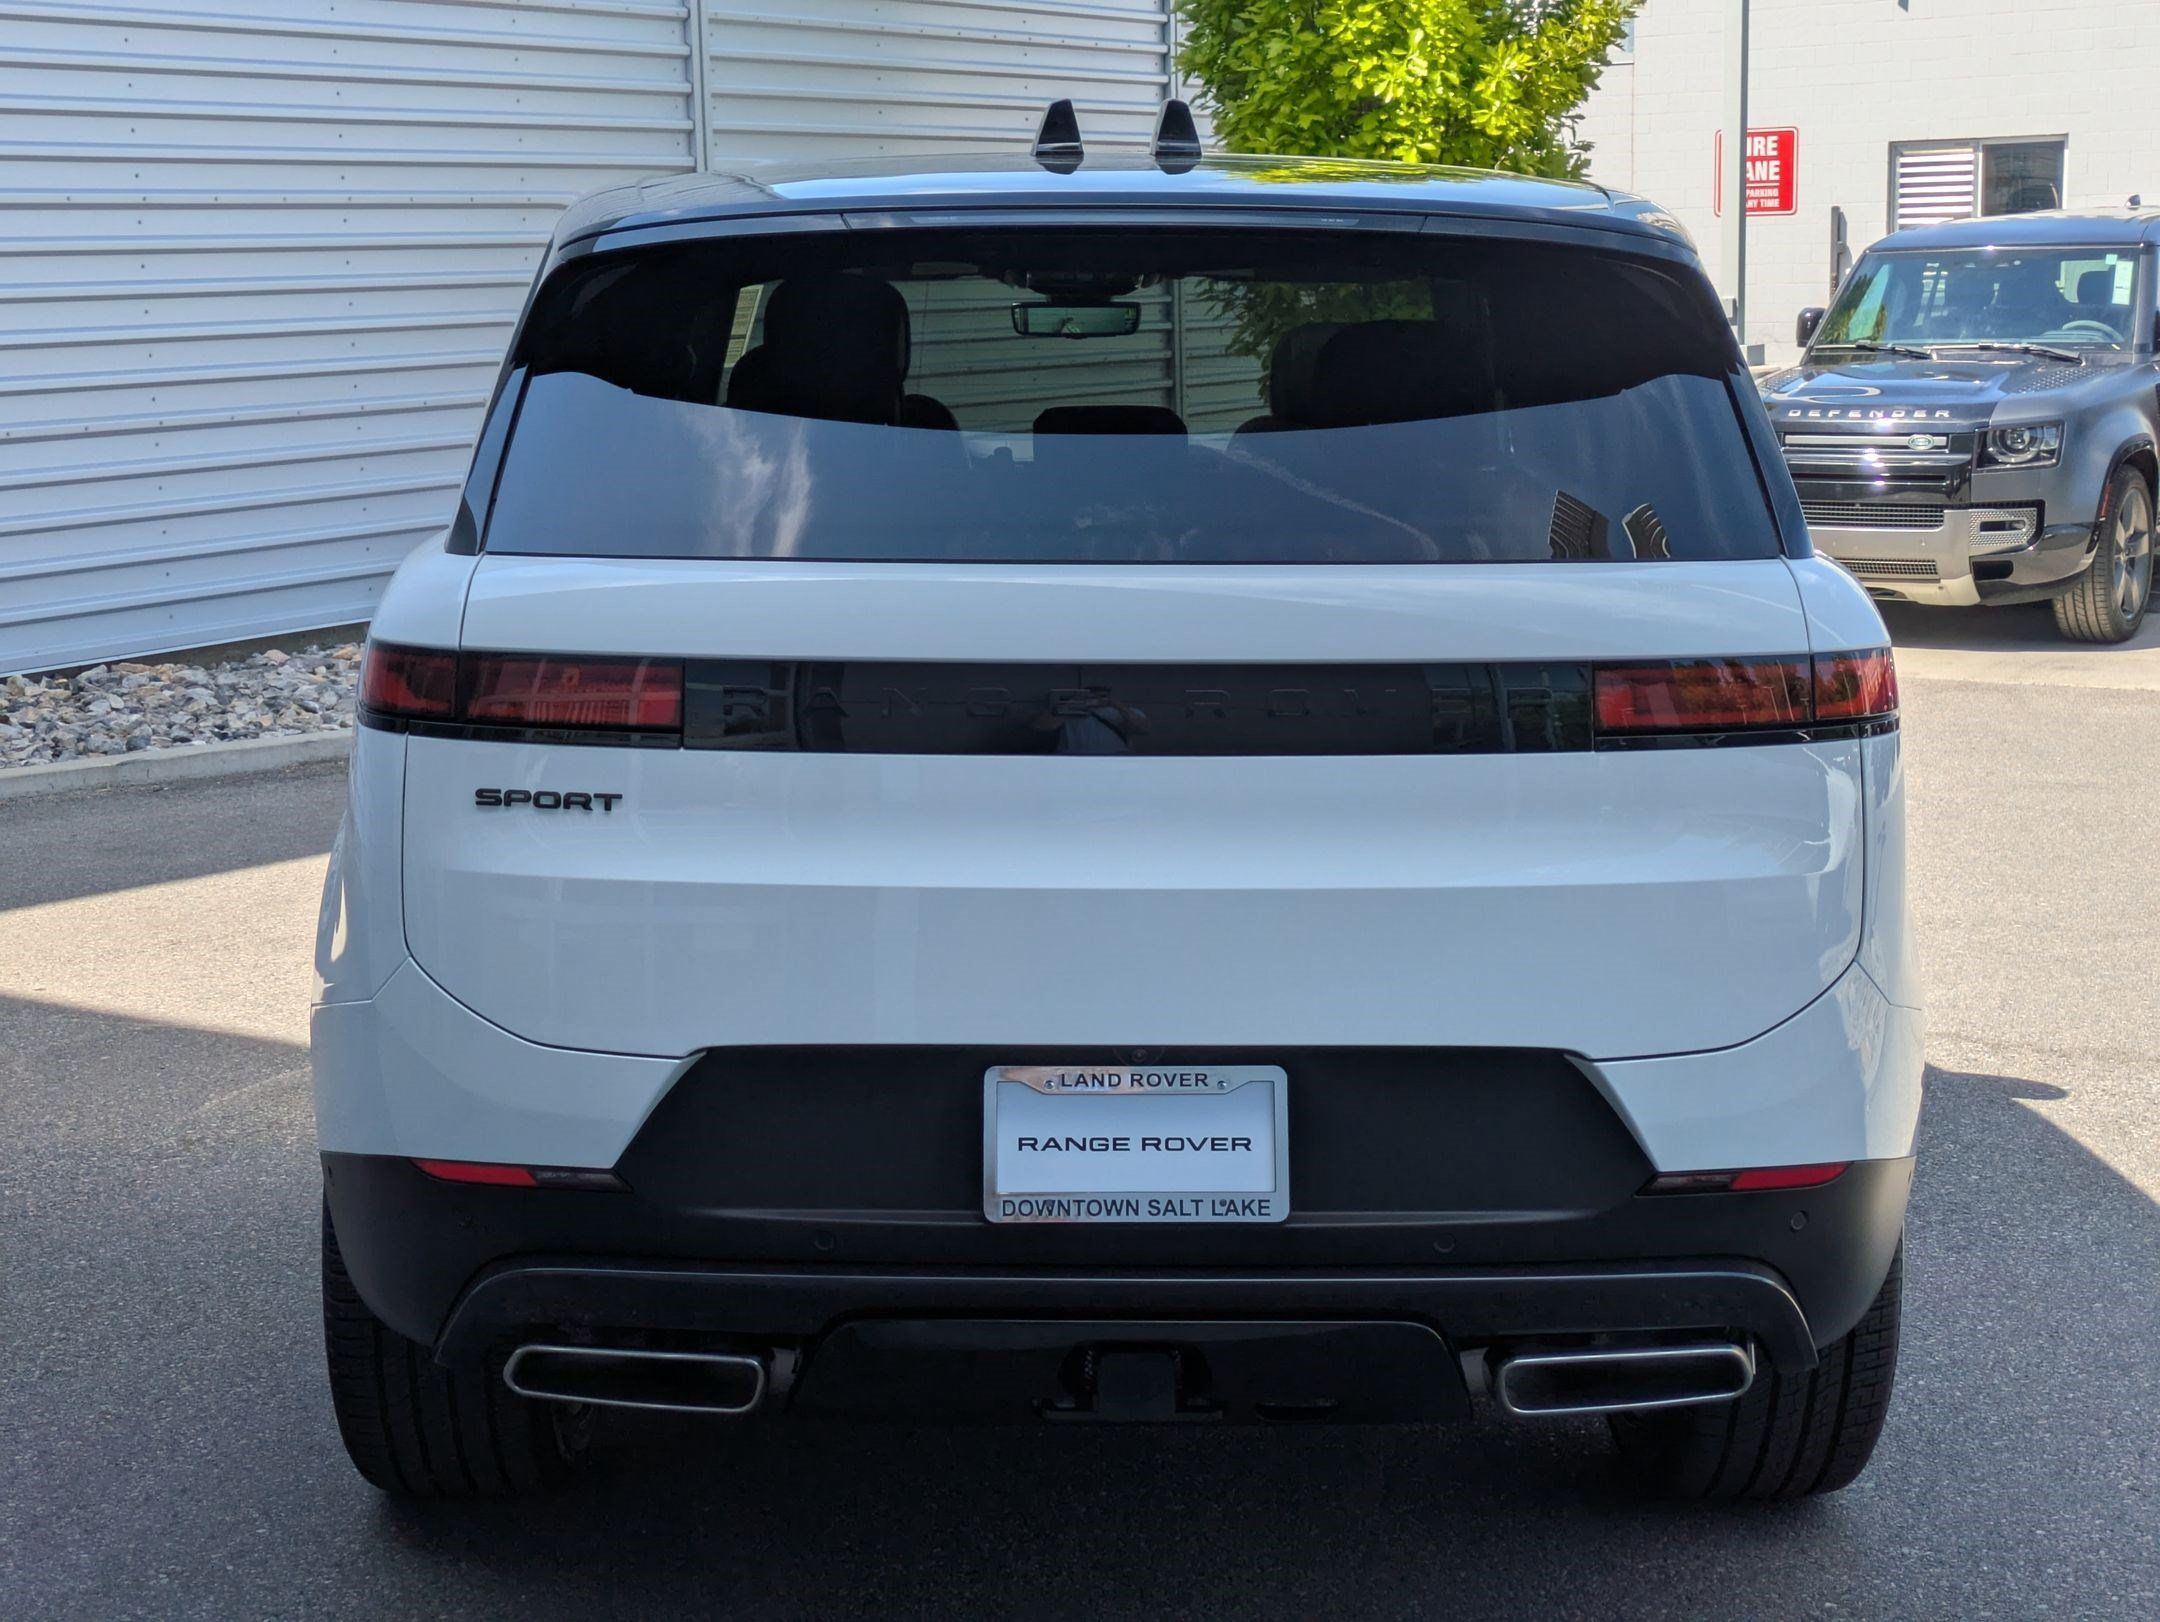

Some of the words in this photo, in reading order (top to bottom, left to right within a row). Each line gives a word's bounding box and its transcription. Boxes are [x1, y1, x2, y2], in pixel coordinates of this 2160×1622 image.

[1746, 135, 1778, 156] IRE
[1746, 160, 1780, 181] ANE
[1760, 198, 1780, 208] TIME
[1788, 409, 1950, 418] DEFENDER
[475, 788, 623, 811] SPORT
[1060, 1073, 1122, 1088] LAND
[1130, 1073, 1209, 1087] ROVER
[1017, 1137, 1131, 1151] RANGE
[1141, 1137, 1252, 1151] ROVER
[1001, 1199, 1140, 1217] DOWNTOWN
[1147, 1199, 1204, 1217] SALT
[1211, 1199, 1271, 1217] LAKE
